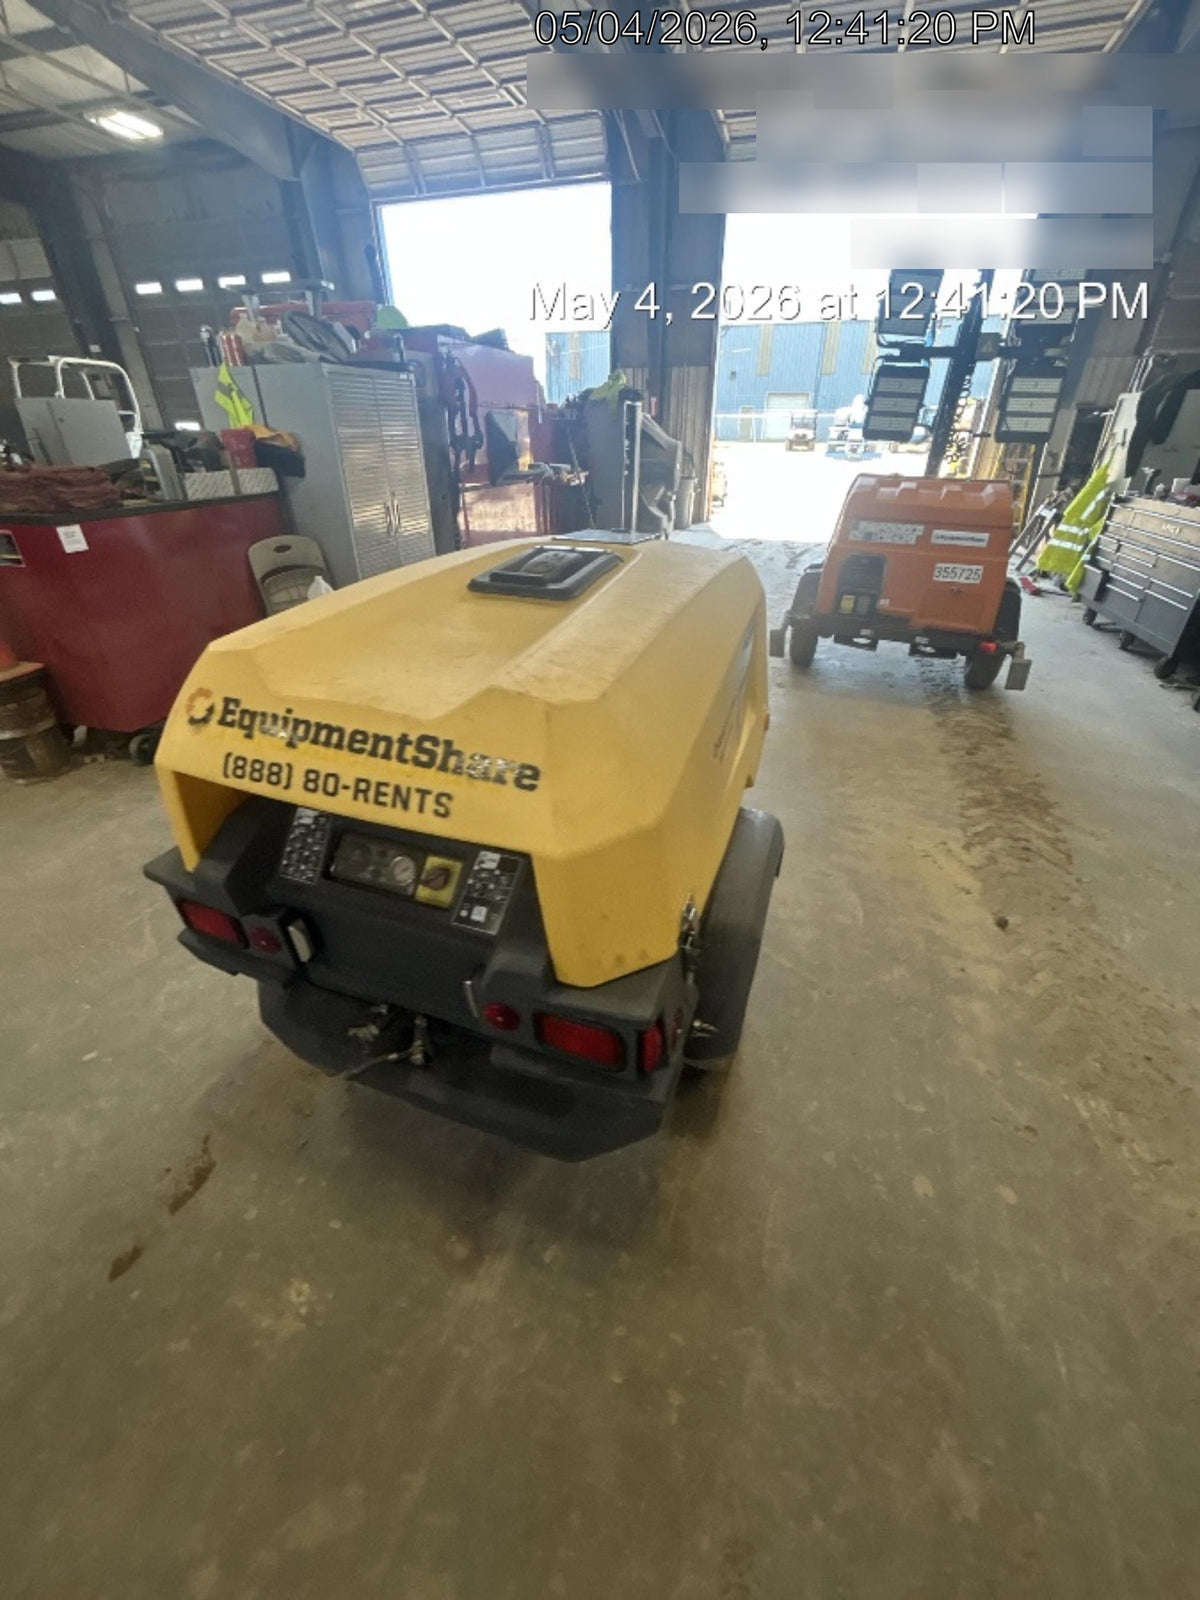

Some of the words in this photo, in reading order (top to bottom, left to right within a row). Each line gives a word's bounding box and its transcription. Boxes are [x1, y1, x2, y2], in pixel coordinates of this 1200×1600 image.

[217, 696, 541, 792] EquipmentShare
[222, 752, 294, 790] (888)
[303, 769, 454, 818] 80-RENTS
